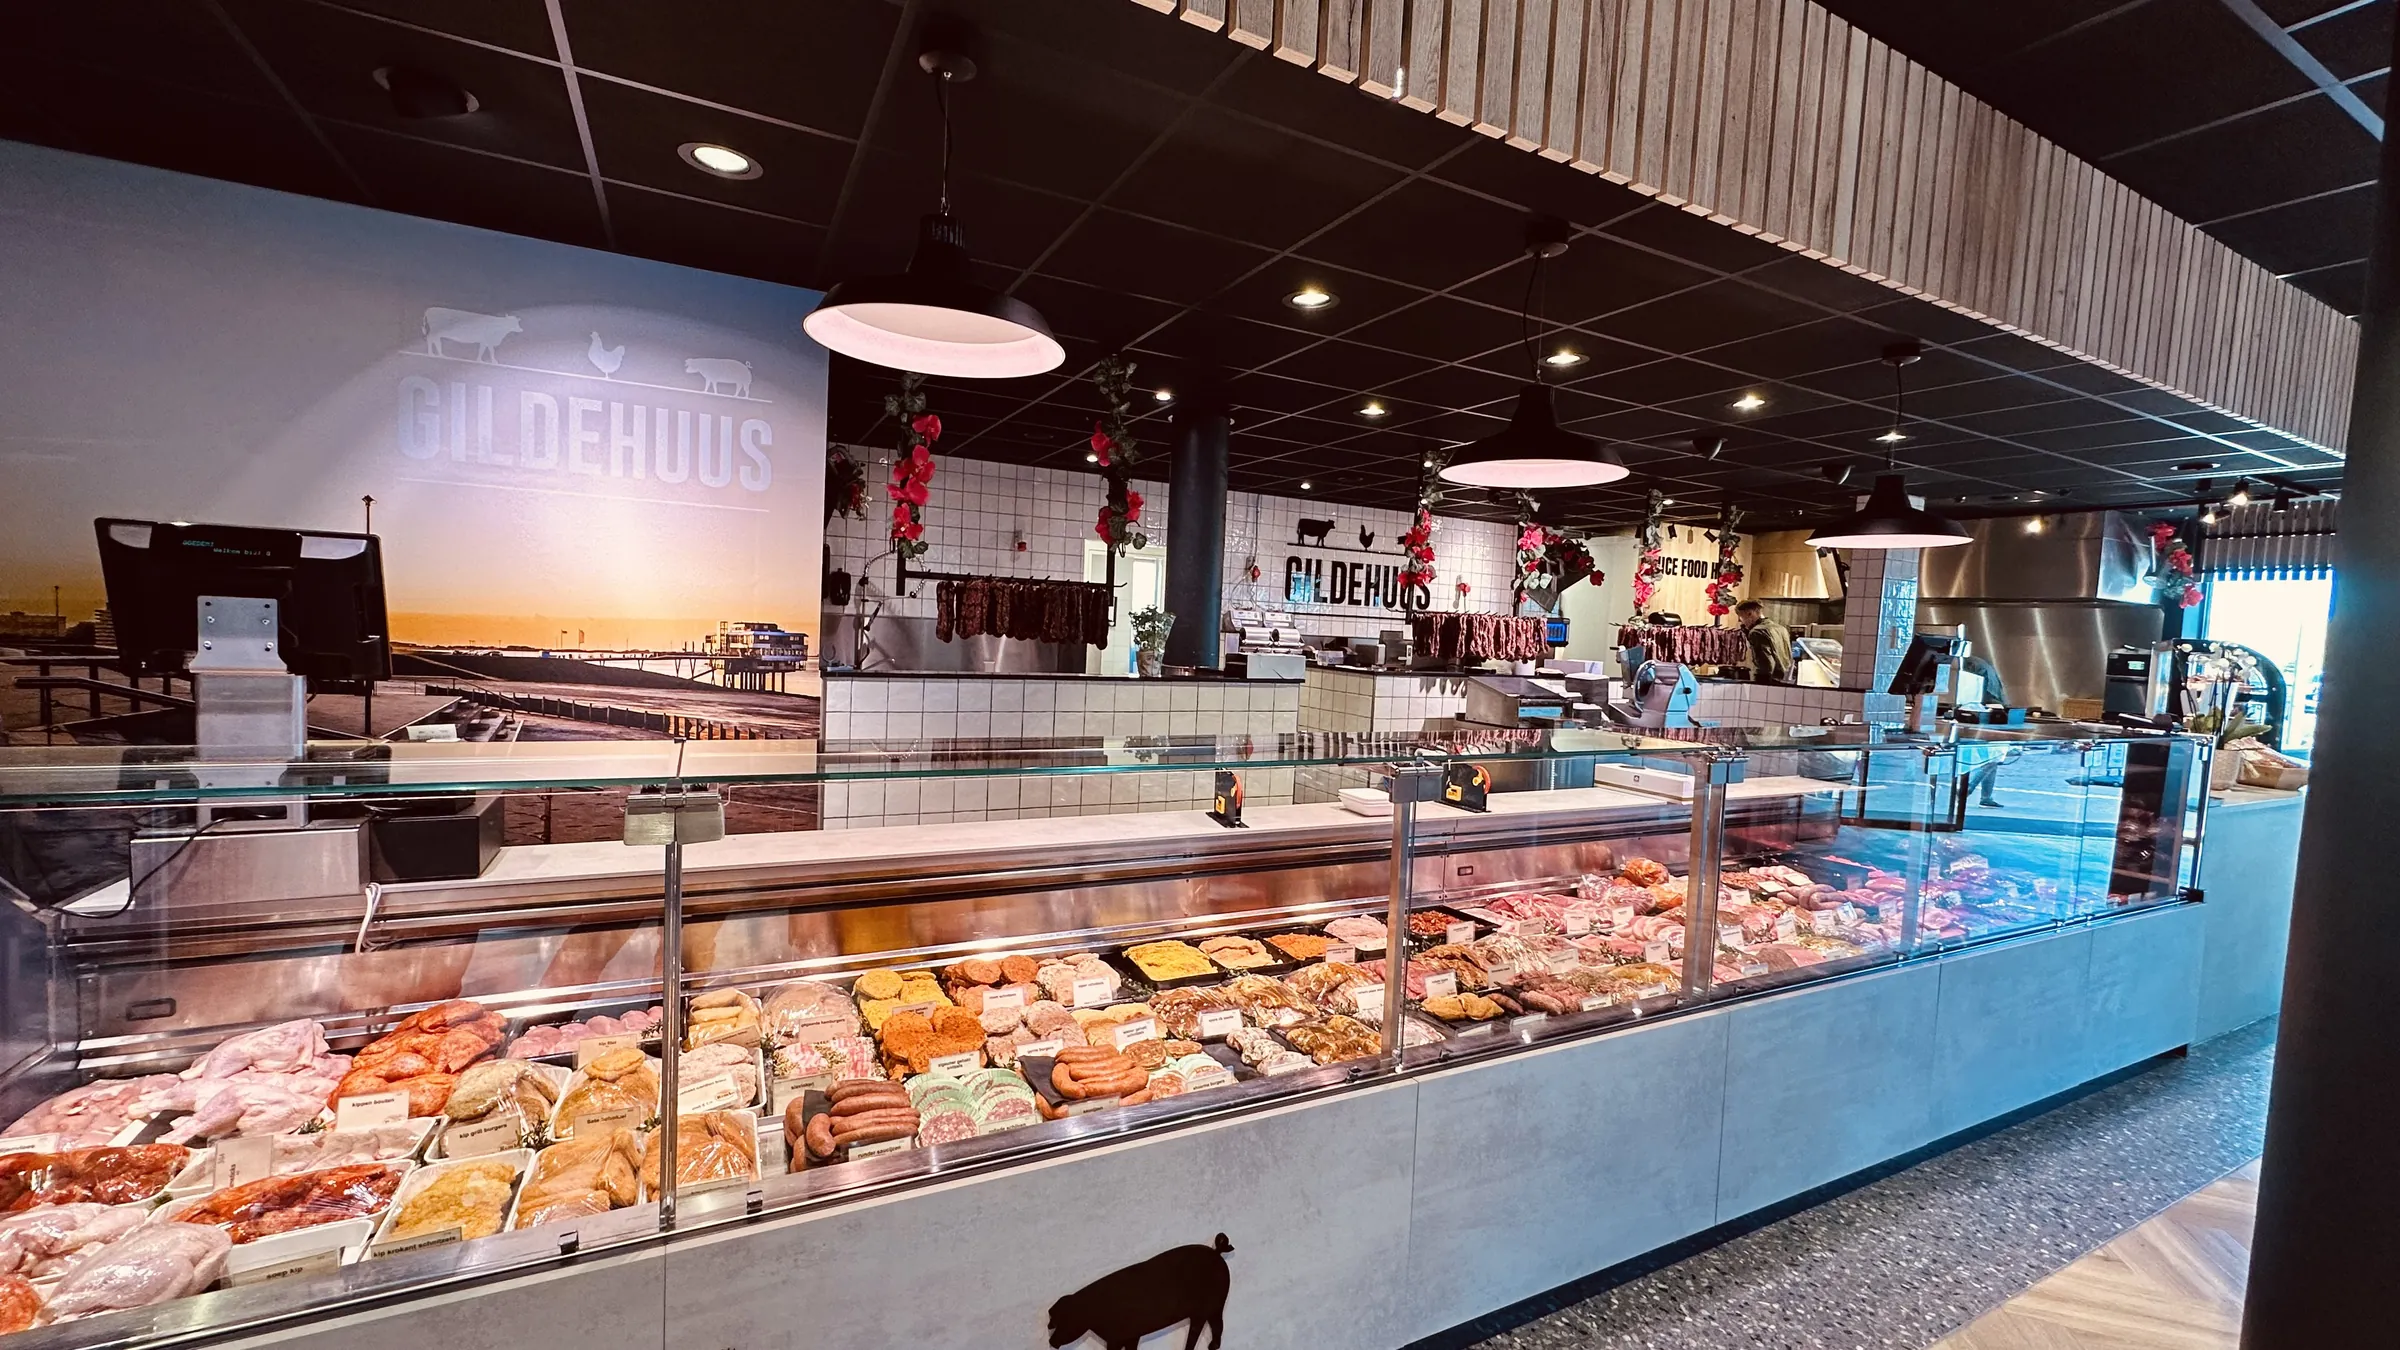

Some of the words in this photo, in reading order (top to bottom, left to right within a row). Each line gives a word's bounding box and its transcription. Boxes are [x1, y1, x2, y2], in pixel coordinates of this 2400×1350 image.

[399, 375, 773, 492] GILDEHUUS
[1657, 556, 1679, 576] ICE
[1680, 558, 1709, 579] FOOD
[470, 1129, 483, 1137] grill
[483, 1123, 508, 1133] burgers
[373, 1250, 386, 1258] kip
[387, 1243, 417, 1255] krokant
[266, 1270, 288, 1278] soep
